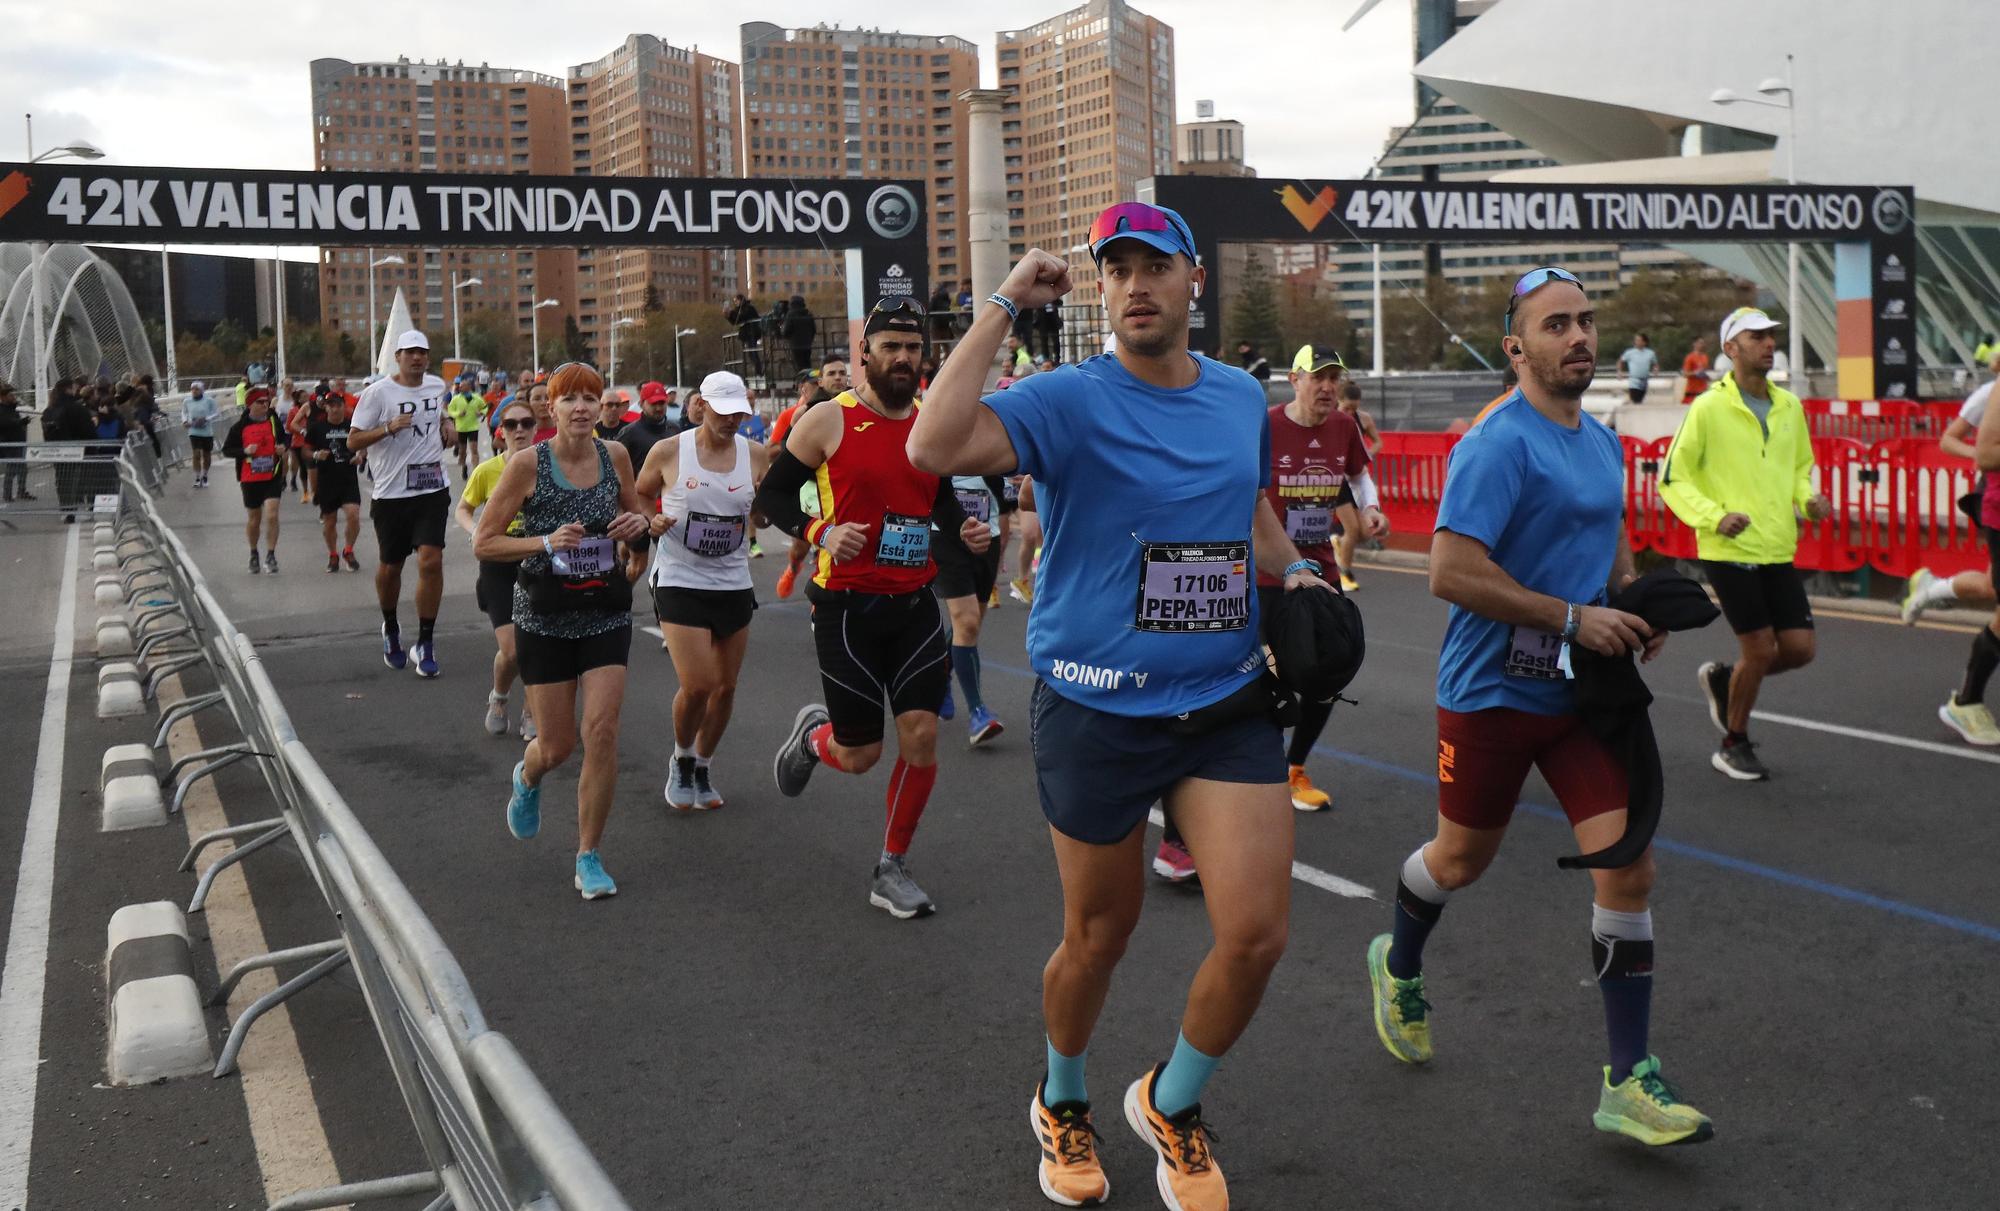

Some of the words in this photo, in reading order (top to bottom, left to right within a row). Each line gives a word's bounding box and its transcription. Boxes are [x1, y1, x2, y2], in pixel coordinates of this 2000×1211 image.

[47, 177, 163, 227] 42K
[168, 180, 421, 232] VALENCIA
[426, 186, 641, 233] TRINIDAD
[647, 189, 851, 234] ALFONSO
[1345, 190, 1418, 229] 42K
[1421, 192, 1581, 230] VALENCIA
[1583, 193, 1725, 230] TRINIDAD
[1726, 194, 1864, 230] ALFONSO
[702, 528, 732, 539] 16422
[567, 546, 600, 559] 18984
[699, 539, 730, 550] MANU
[881, 544, 905, 557] Está
[1173, 574, 1228, 593] 17106
[1146, 596, 1244, 619] PEPA-TONI
[1052, 659, 1123, 690] JUNIOR
[1439, 740, 1455, 783] FILA
